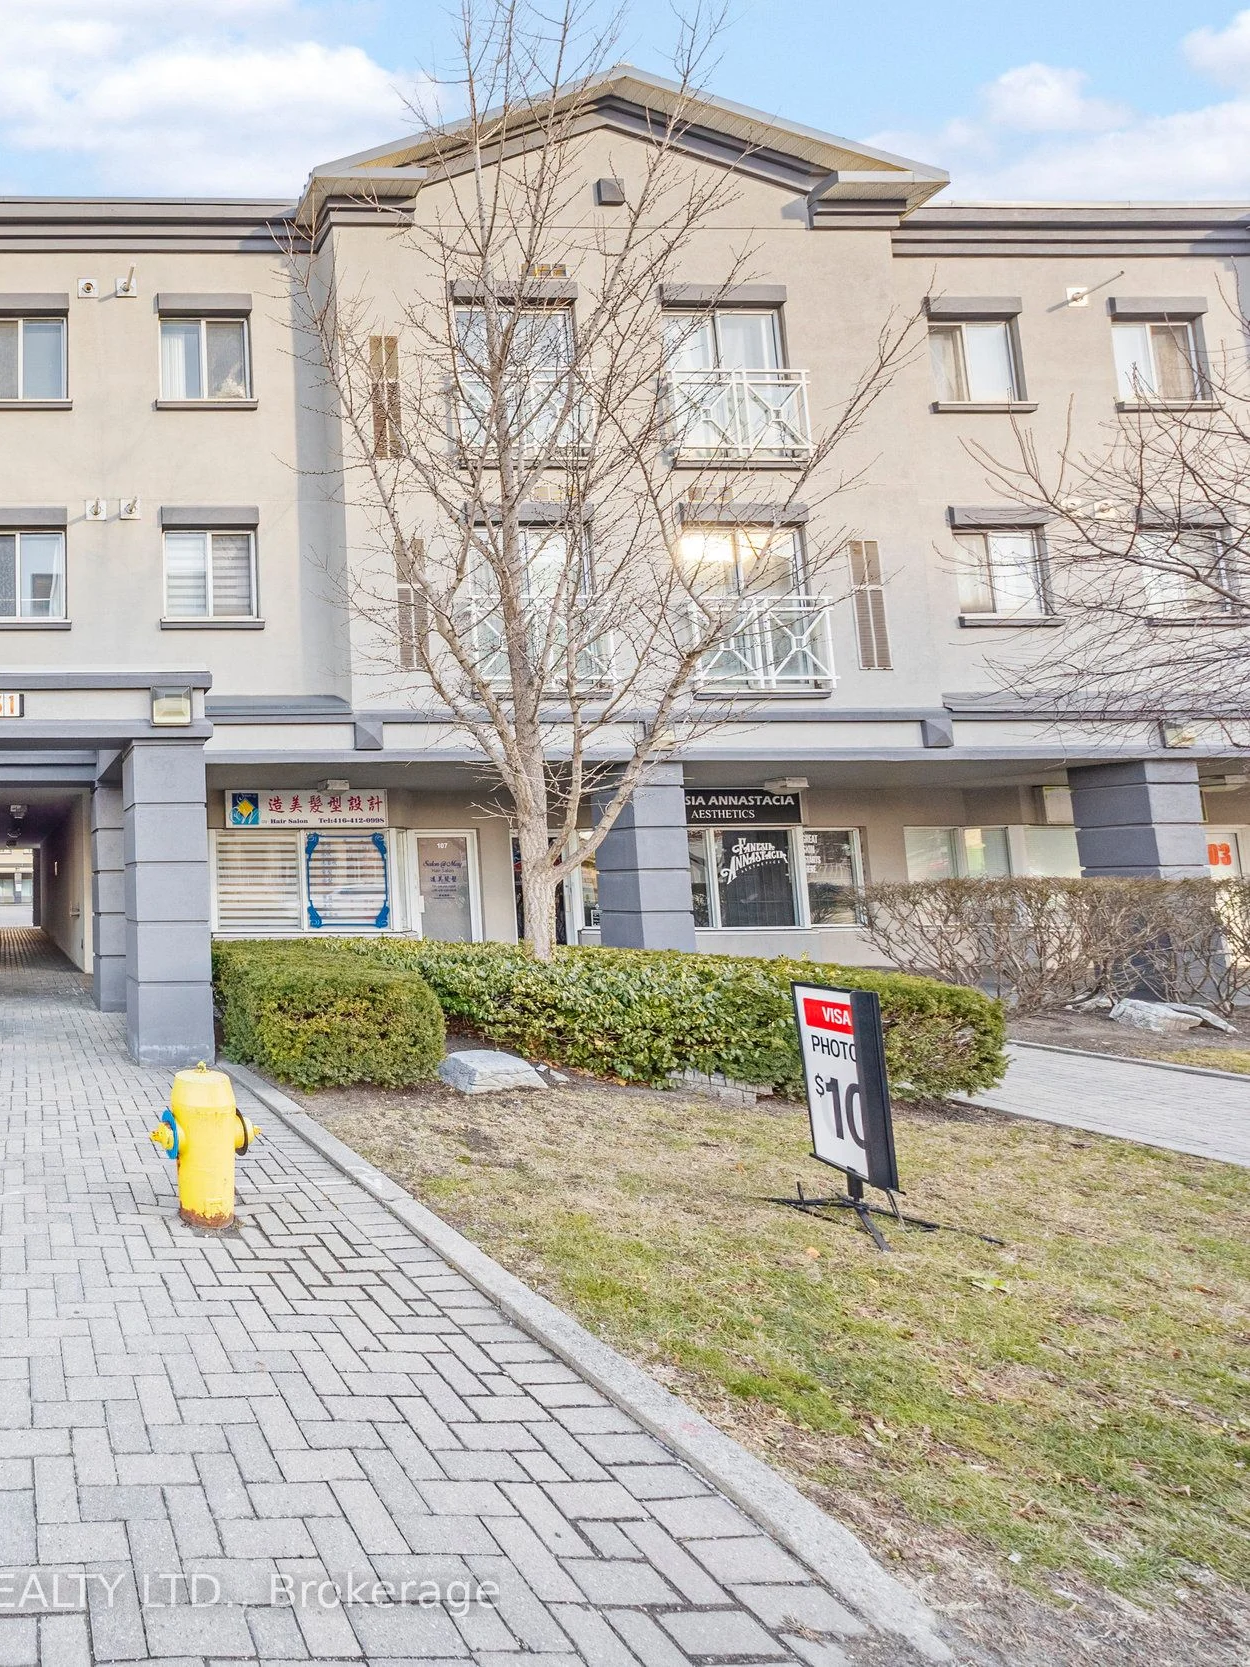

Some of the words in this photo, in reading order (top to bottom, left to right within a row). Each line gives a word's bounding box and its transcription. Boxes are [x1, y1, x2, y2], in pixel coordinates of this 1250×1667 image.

[708, 795, 794, 805] ANNASTACIA
[691, 809, 755, 818] AESTHETICS
[1207, 843, 1232, 865] 03
[821, 1006, 852, 1026] VISA
